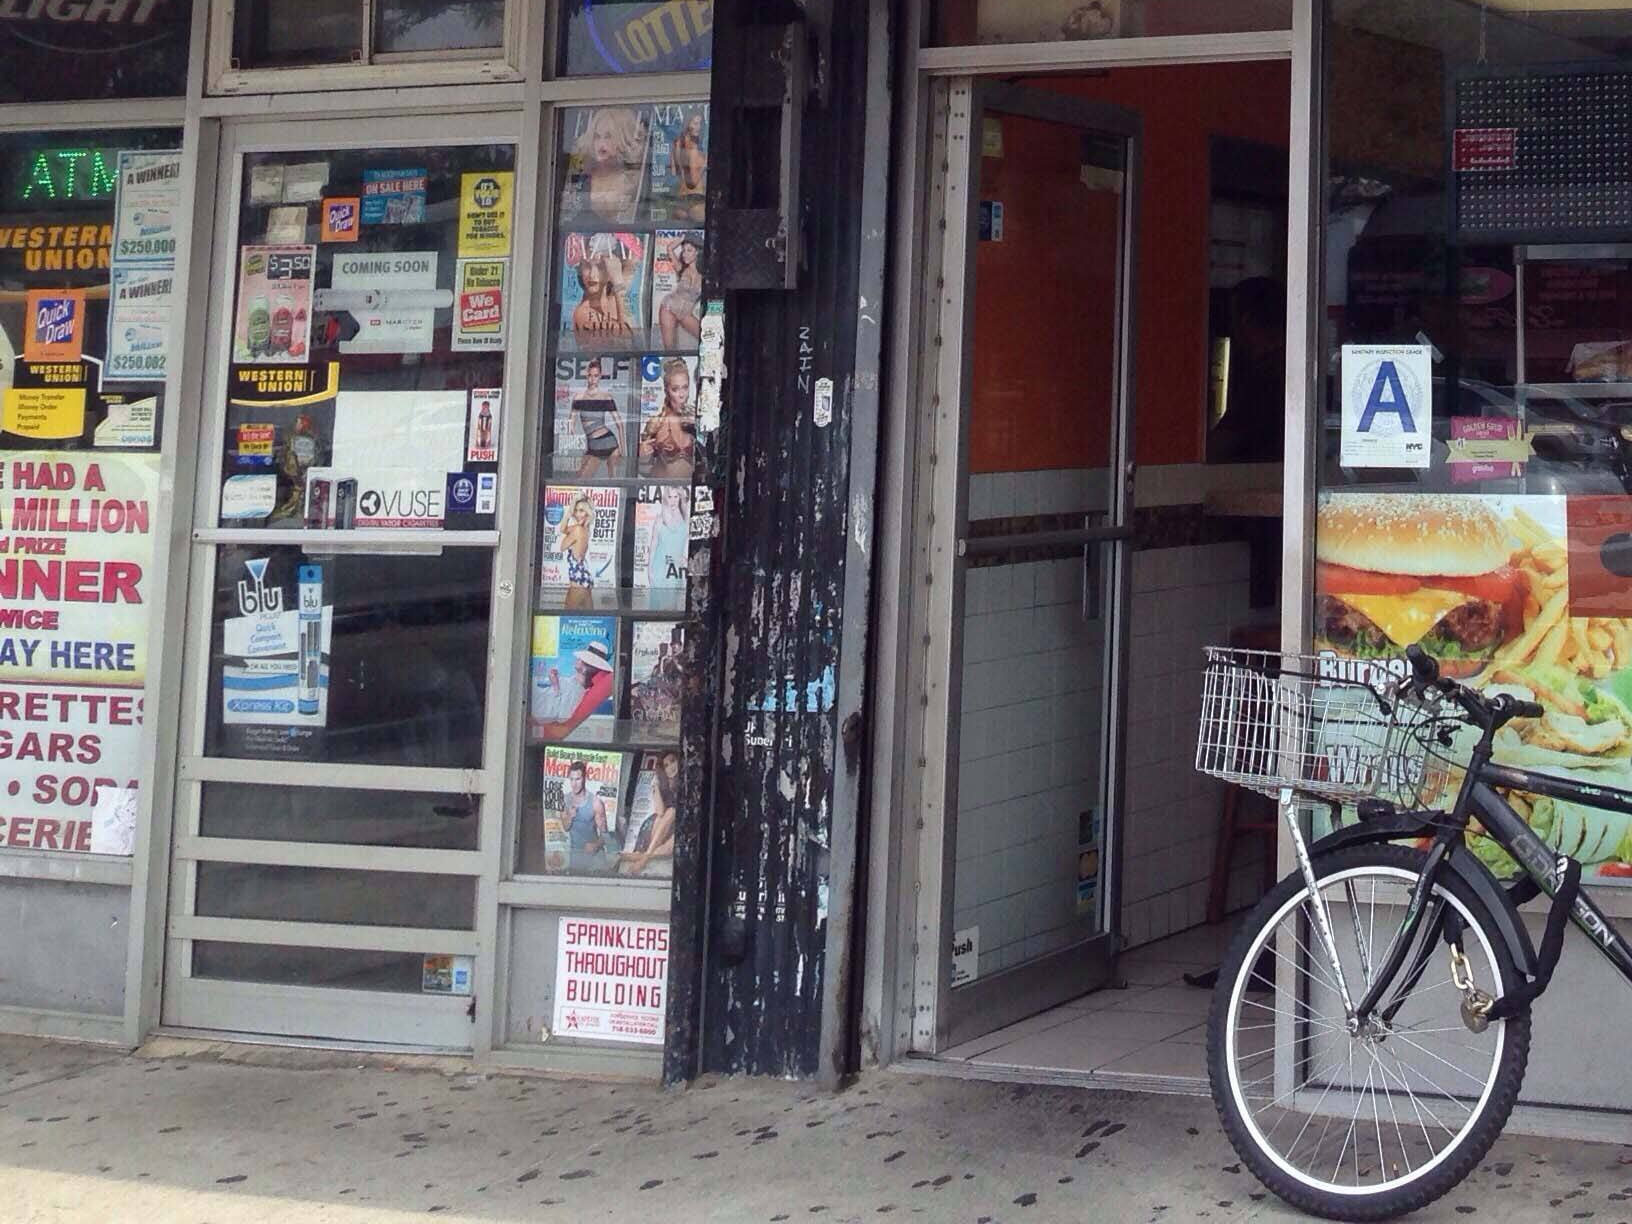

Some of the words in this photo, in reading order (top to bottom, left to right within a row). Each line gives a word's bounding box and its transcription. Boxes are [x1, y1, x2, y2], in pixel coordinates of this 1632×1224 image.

[23, 152, 119, 198] ATM
[342, 262, 391, 274] COMING
[393, 260, 430, 273] SOON
[468, 293, 494, 308] We
[38, 300, 70, 328] Quick
[463, 305, 500, 323] Card
[45, 319, 75, 344] Draw
[30, 365, 80, 374] WESTERN
[44, 373, 80, 383] UNION
[238, 370, 304, 382] WESTERN
[257, 382, 305, 393] UNION
[1356, 360, 1418, 433] A
[470, 450, 495, 461] PUSH
[1405, 442, 1423, 450] NYC
[13, 462, 76, 491] HAD
[83, 463, 106, 492] A
[381, 489, 441, 517] VUSE
[12, 497, 150, 534] MILLION
[595, 509, 616, 518] YOUR
[594, 519, 616, 529] BEST
[593, 529, 616, 539] BUTT
[14, 536, 67, 555] PRIZE
[238, 579, 284, 616] blu
[303, 595, 318, 609] blu
[51, 641, 136, 671] HERE
[33, 774, 139, 807] SO
[566, 922, 668, 952] SPRINKLERS
[565, 951, 667, 980] THROUGHOUT
[567, 979, 662, 1009] BUILDING
